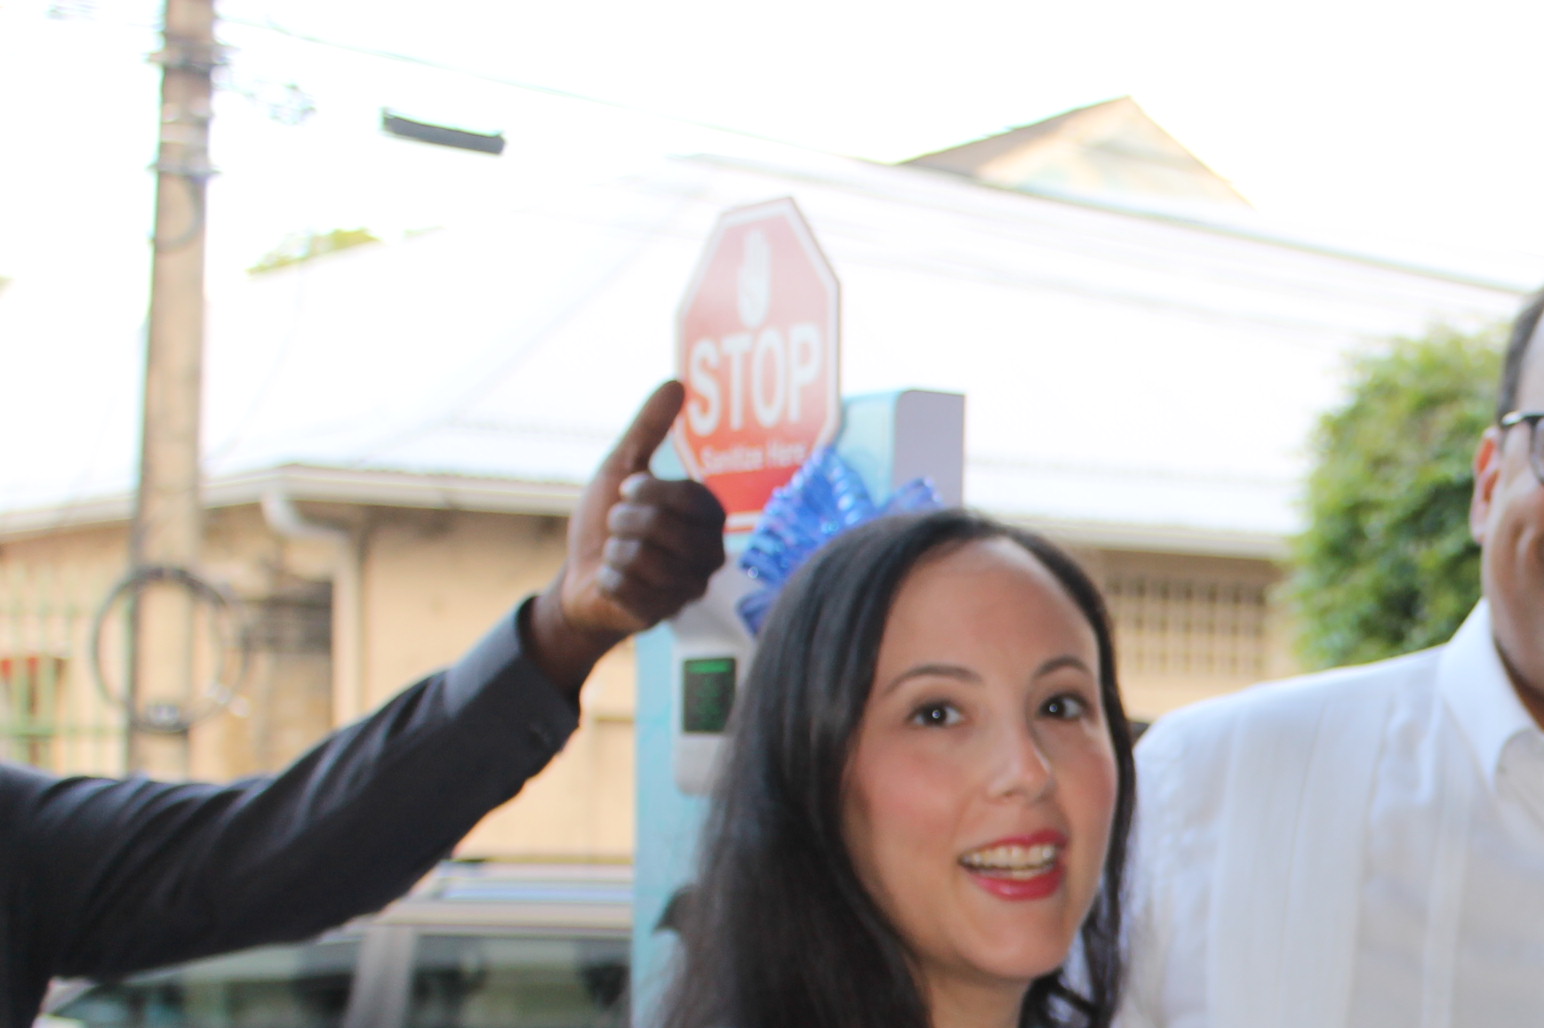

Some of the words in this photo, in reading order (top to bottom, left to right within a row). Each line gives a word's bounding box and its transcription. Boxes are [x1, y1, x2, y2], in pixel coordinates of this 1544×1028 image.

[688, 321, 823, 437] STOP
[702, 444, 764, 475] Sanitize
[766, 438, 806, 469] Here
